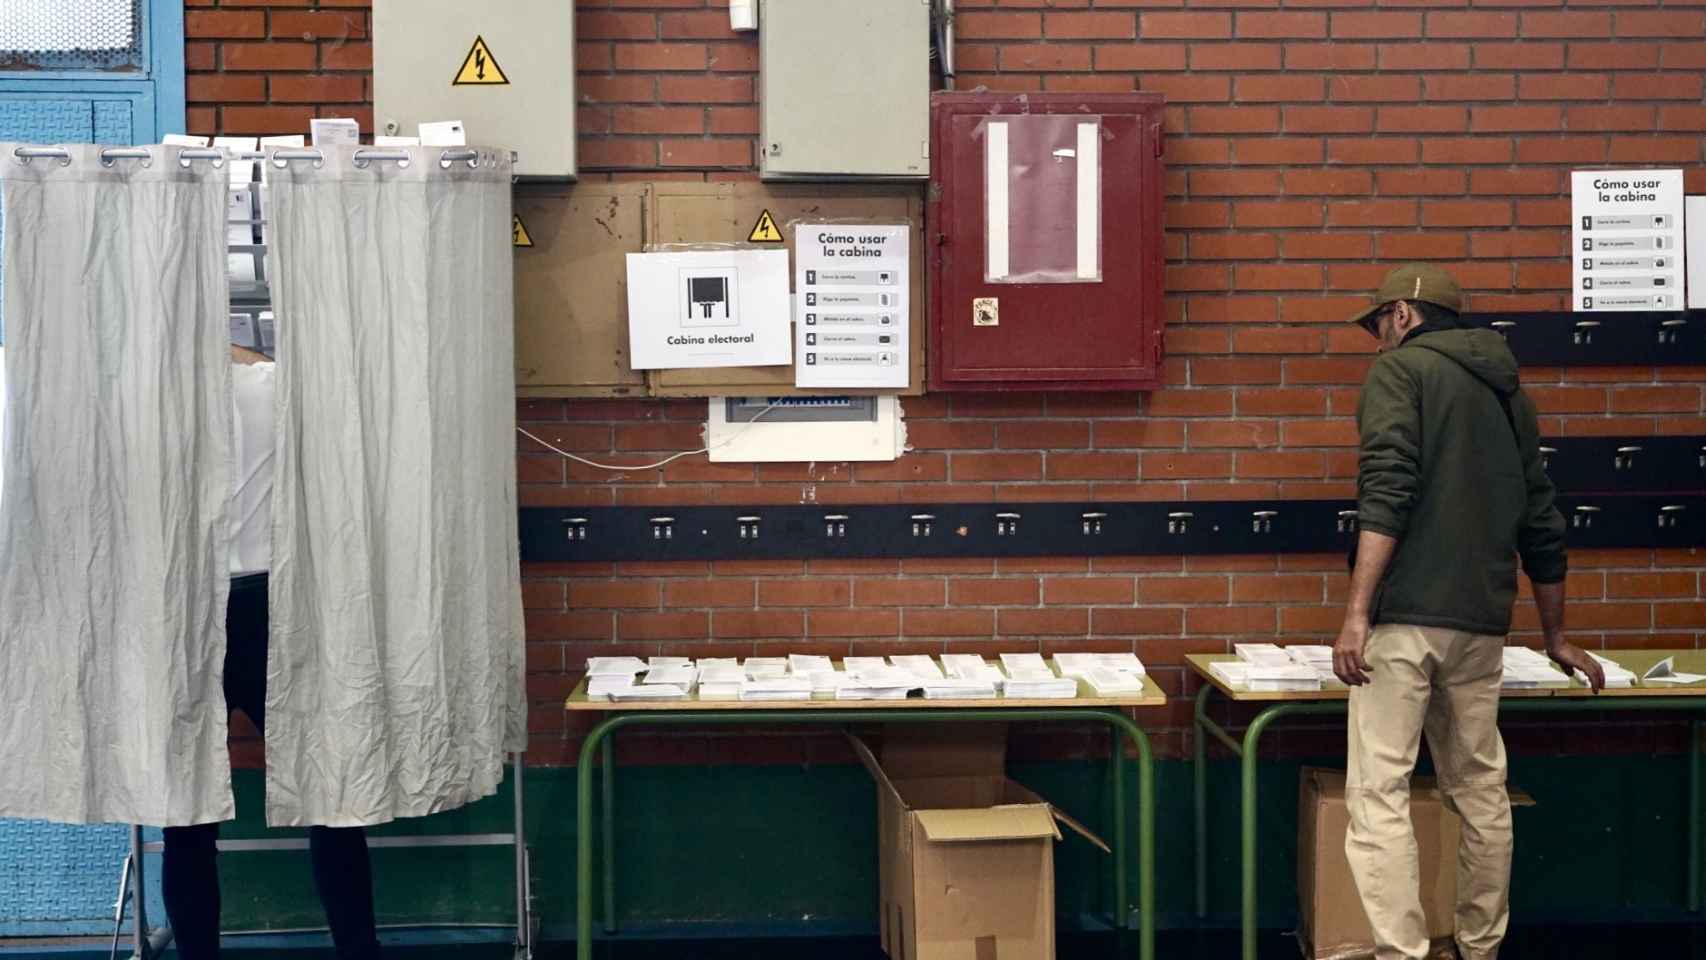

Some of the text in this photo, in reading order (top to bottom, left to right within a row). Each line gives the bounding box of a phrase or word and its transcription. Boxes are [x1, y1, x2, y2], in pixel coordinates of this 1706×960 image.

[1593, 177, 1661, 189] Cómo usar
[1598, 191, 1656, 202] la cabina
[818, 233, 887, 244] Cómo usar
[823, 246, 882, 257] la cabina
[667, 332, 754, 346] Cabina electoral
